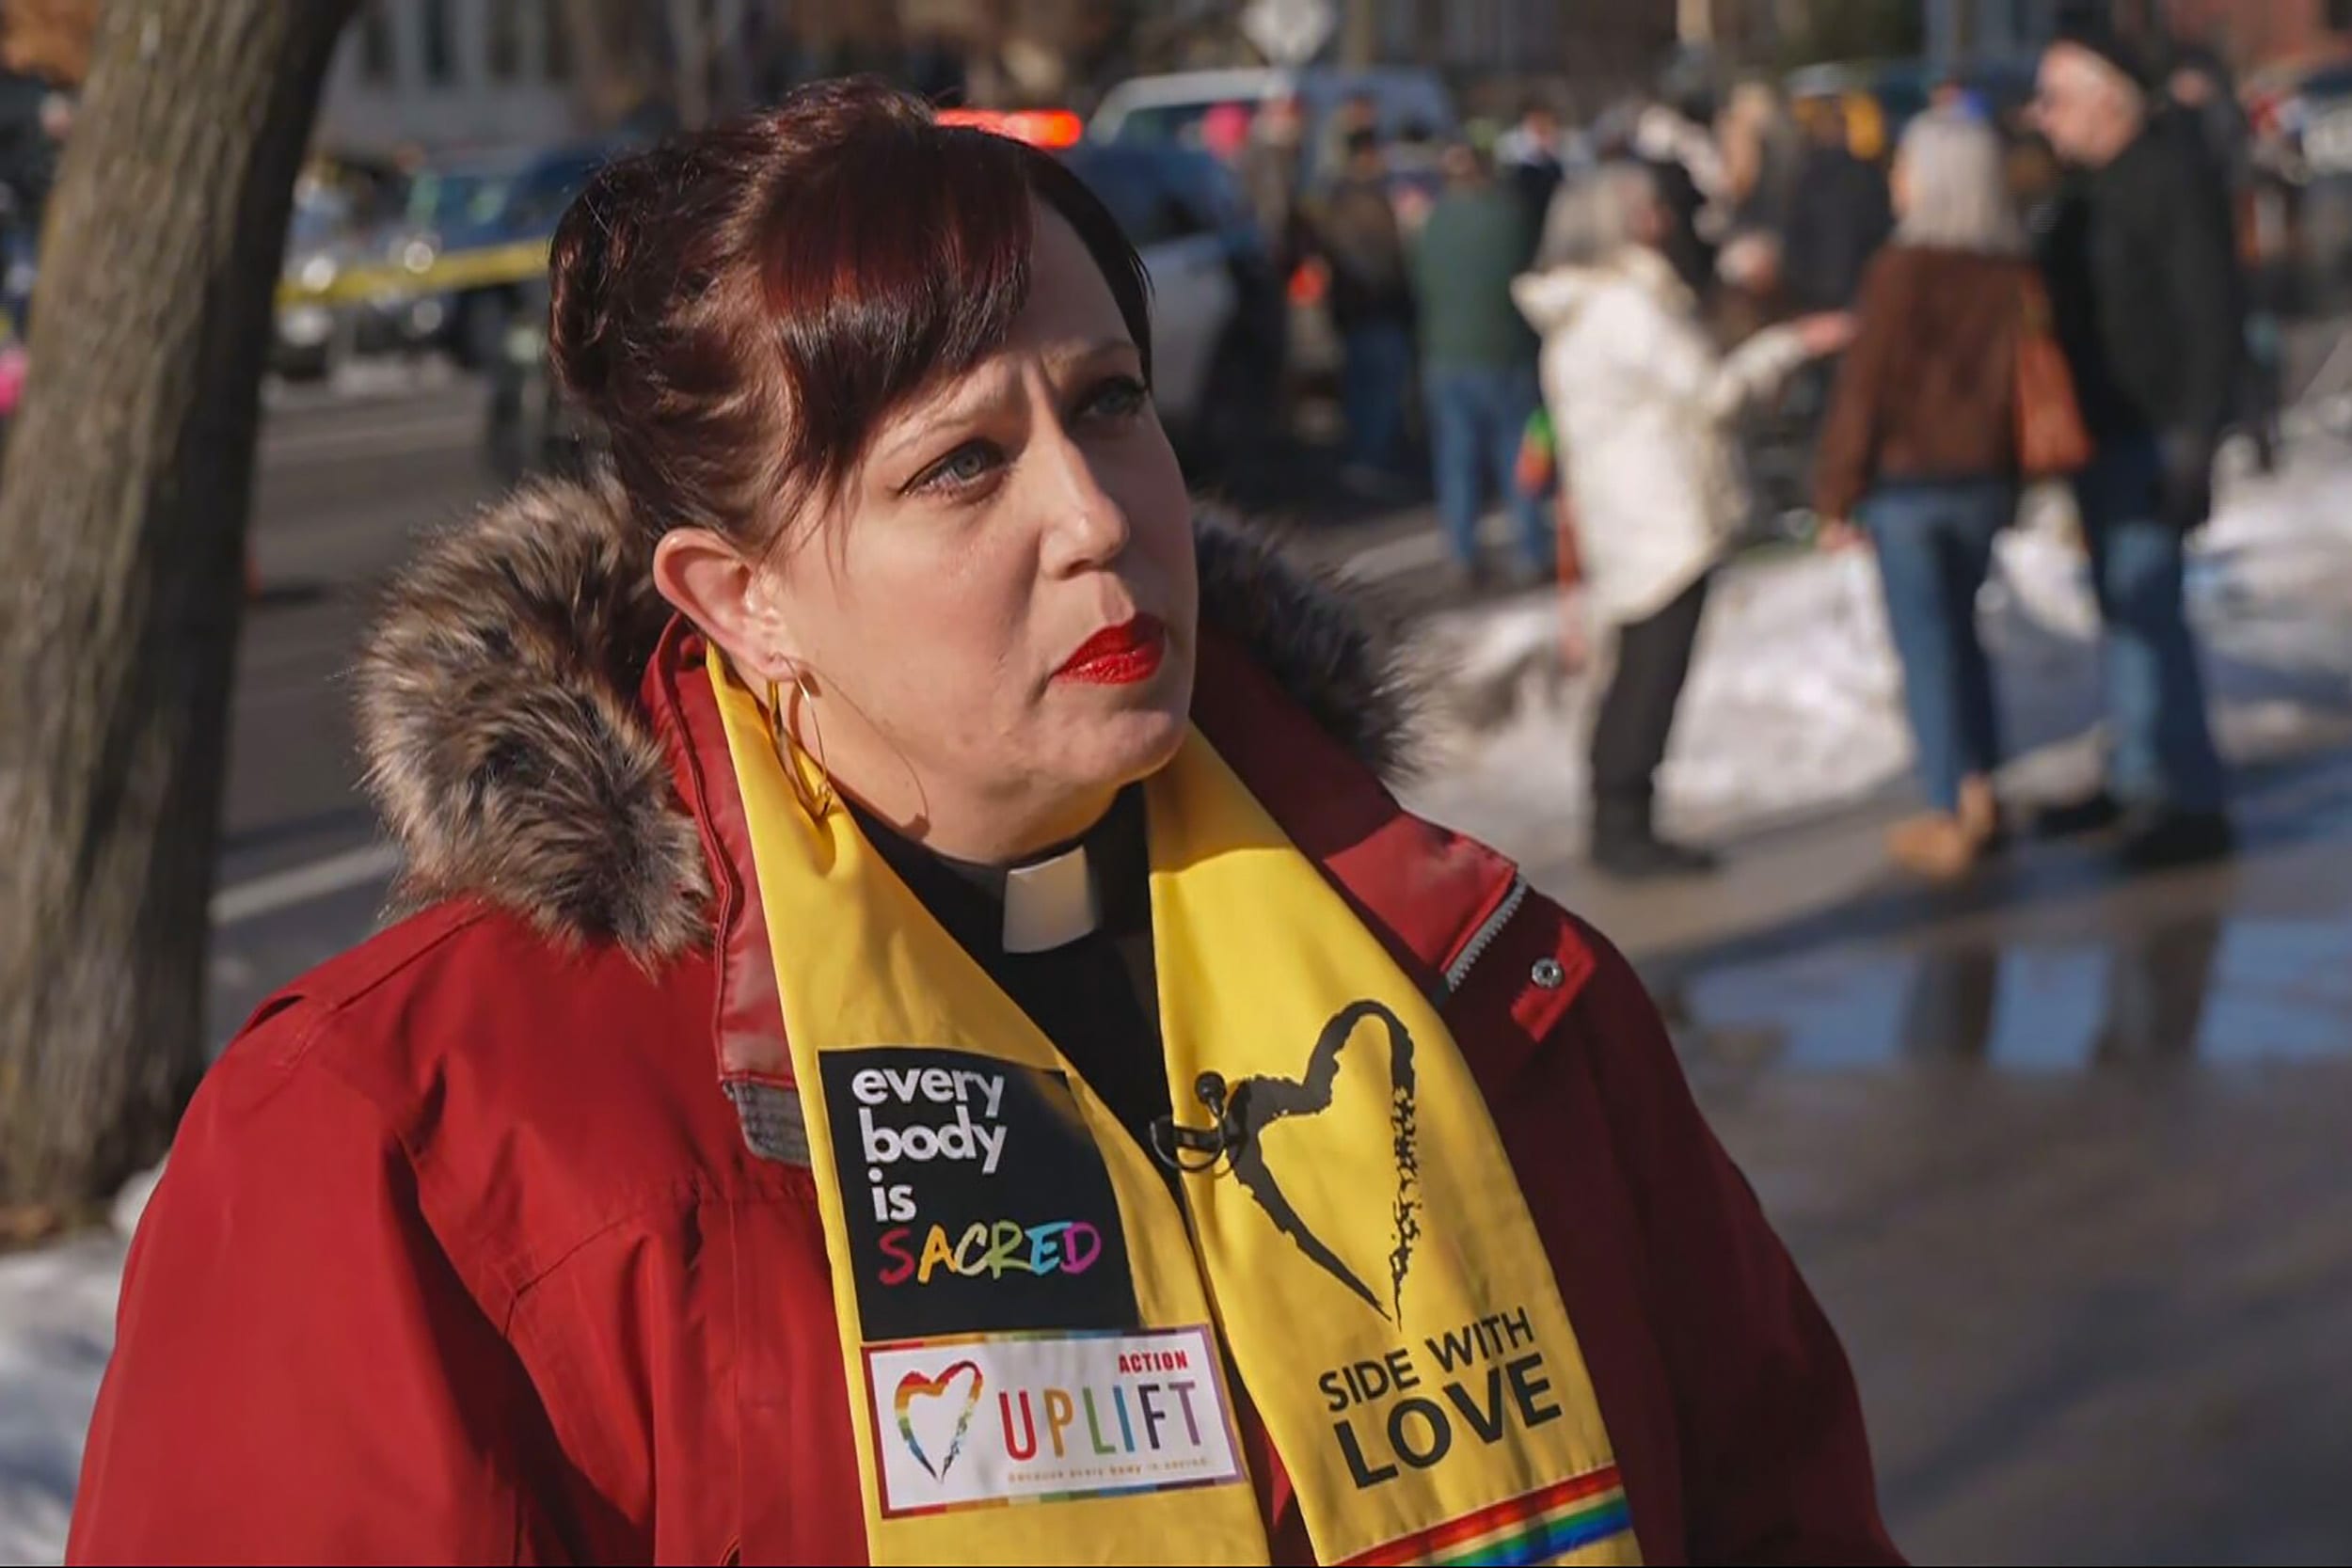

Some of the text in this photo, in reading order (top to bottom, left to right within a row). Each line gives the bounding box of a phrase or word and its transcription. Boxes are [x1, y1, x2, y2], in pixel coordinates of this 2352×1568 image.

[851, 1068, 1004, 1117] every
[858, 1105, 1007, 1173] body
[867, 1167, 916, 1221] is
[879, 1221, 1102, 1285] SACRED
[1119, 1352, 1188, 1373] ACTION
[1318, 1307, 1534, 1412] SIDE WITH
[998, 1381, 1201, 1461] UPLIFT
[1333, 1353, 1563, 1489] LOVE
